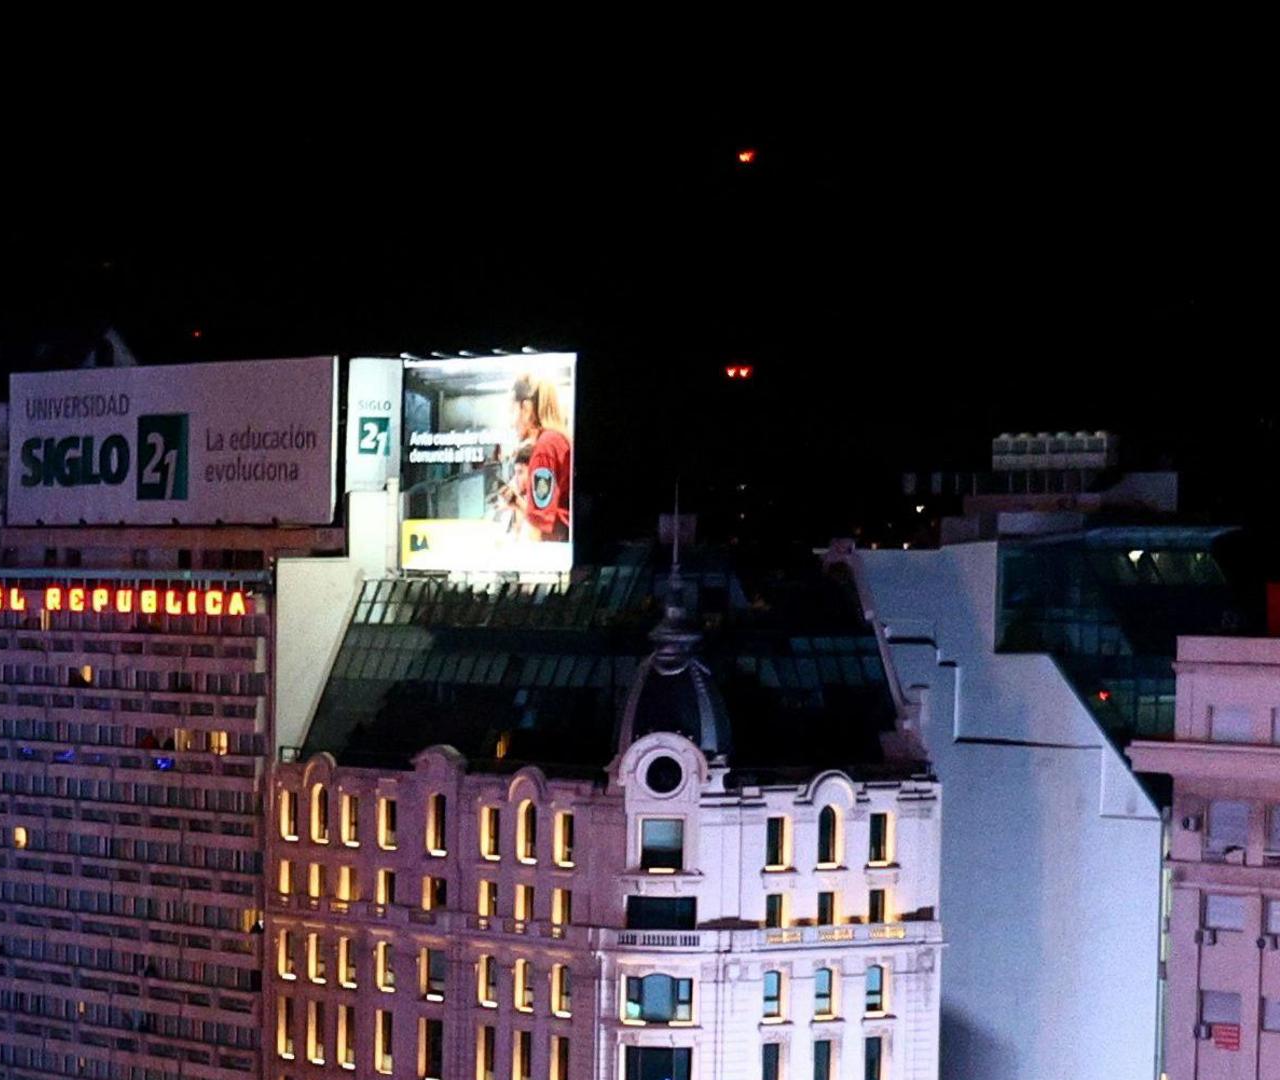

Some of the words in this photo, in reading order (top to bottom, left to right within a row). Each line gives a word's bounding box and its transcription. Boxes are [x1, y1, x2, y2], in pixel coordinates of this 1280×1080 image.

[25, 394, 130, 420] UNIVERSIDAD
[359, 400, 391, 411] SIGLO
[206, 427, 224, 451] La
[229, 425, 317, 451] educación
[360, 422, 388, 455] 21
[20, 433, 130, 487] SIGLO
[142, 432, 176, 500] 21
[204, 456, 299, 482] evoluciona
[46, 588, 246, 615] REPUBLICA
